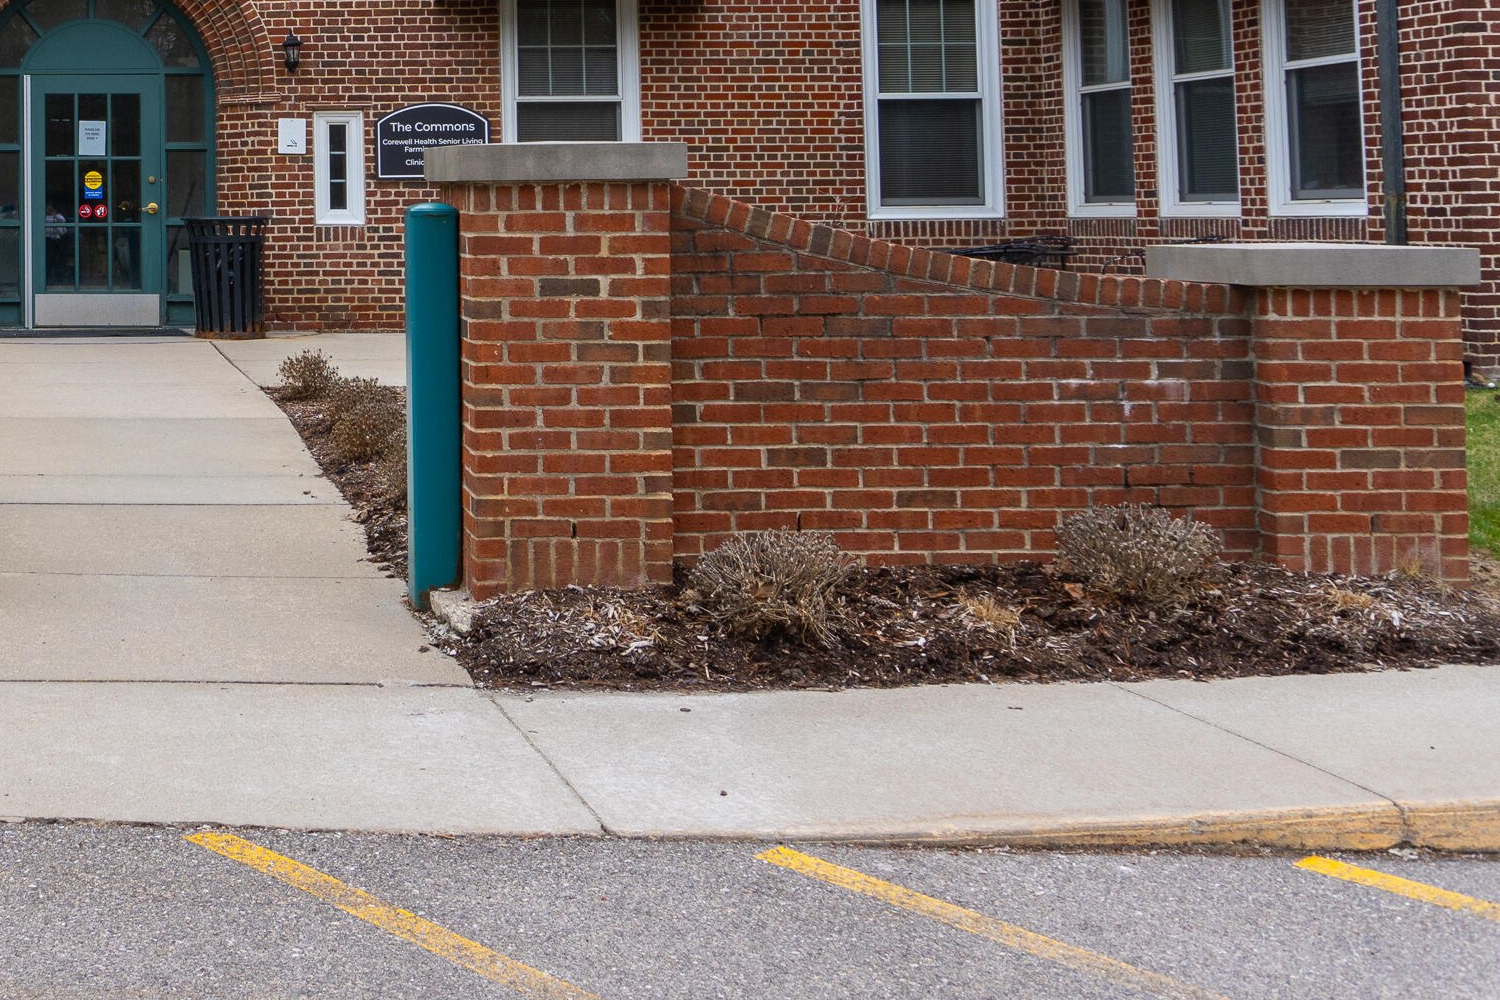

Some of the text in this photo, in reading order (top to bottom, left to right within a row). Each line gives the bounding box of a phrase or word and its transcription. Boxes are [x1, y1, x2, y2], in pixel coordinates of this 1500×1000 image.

[390, 122, 475, 132] The Commons
[462, 137, 483, 145] Living
[404, 145, 426, 153] Farmi
